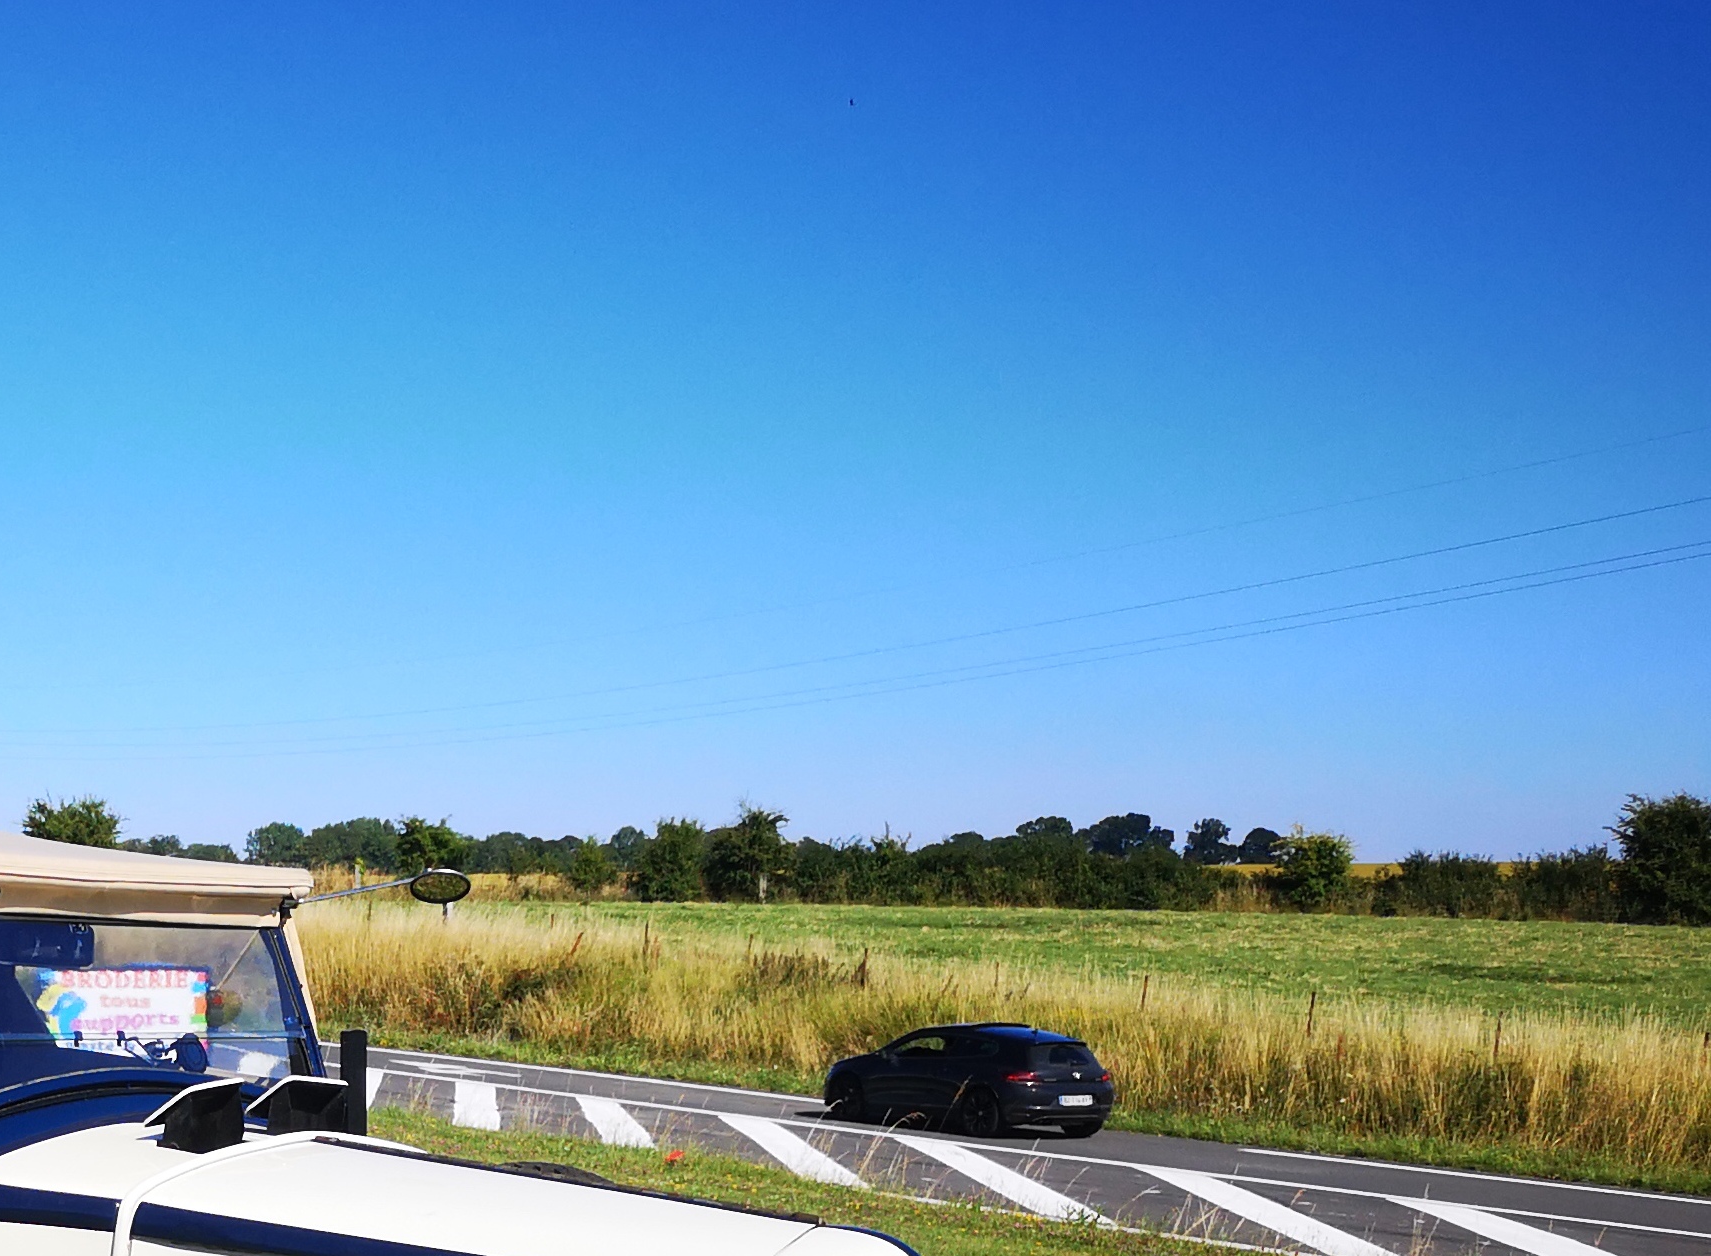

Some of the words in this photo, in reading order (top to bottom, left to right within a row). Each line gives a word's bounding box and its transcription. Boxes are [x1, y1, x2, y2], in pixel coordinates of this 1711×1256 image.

[61, 970, 187, 988] BRODERIE
[100, 994, 151, 1008] tous
[71, 1013, 179, 1034] supports
